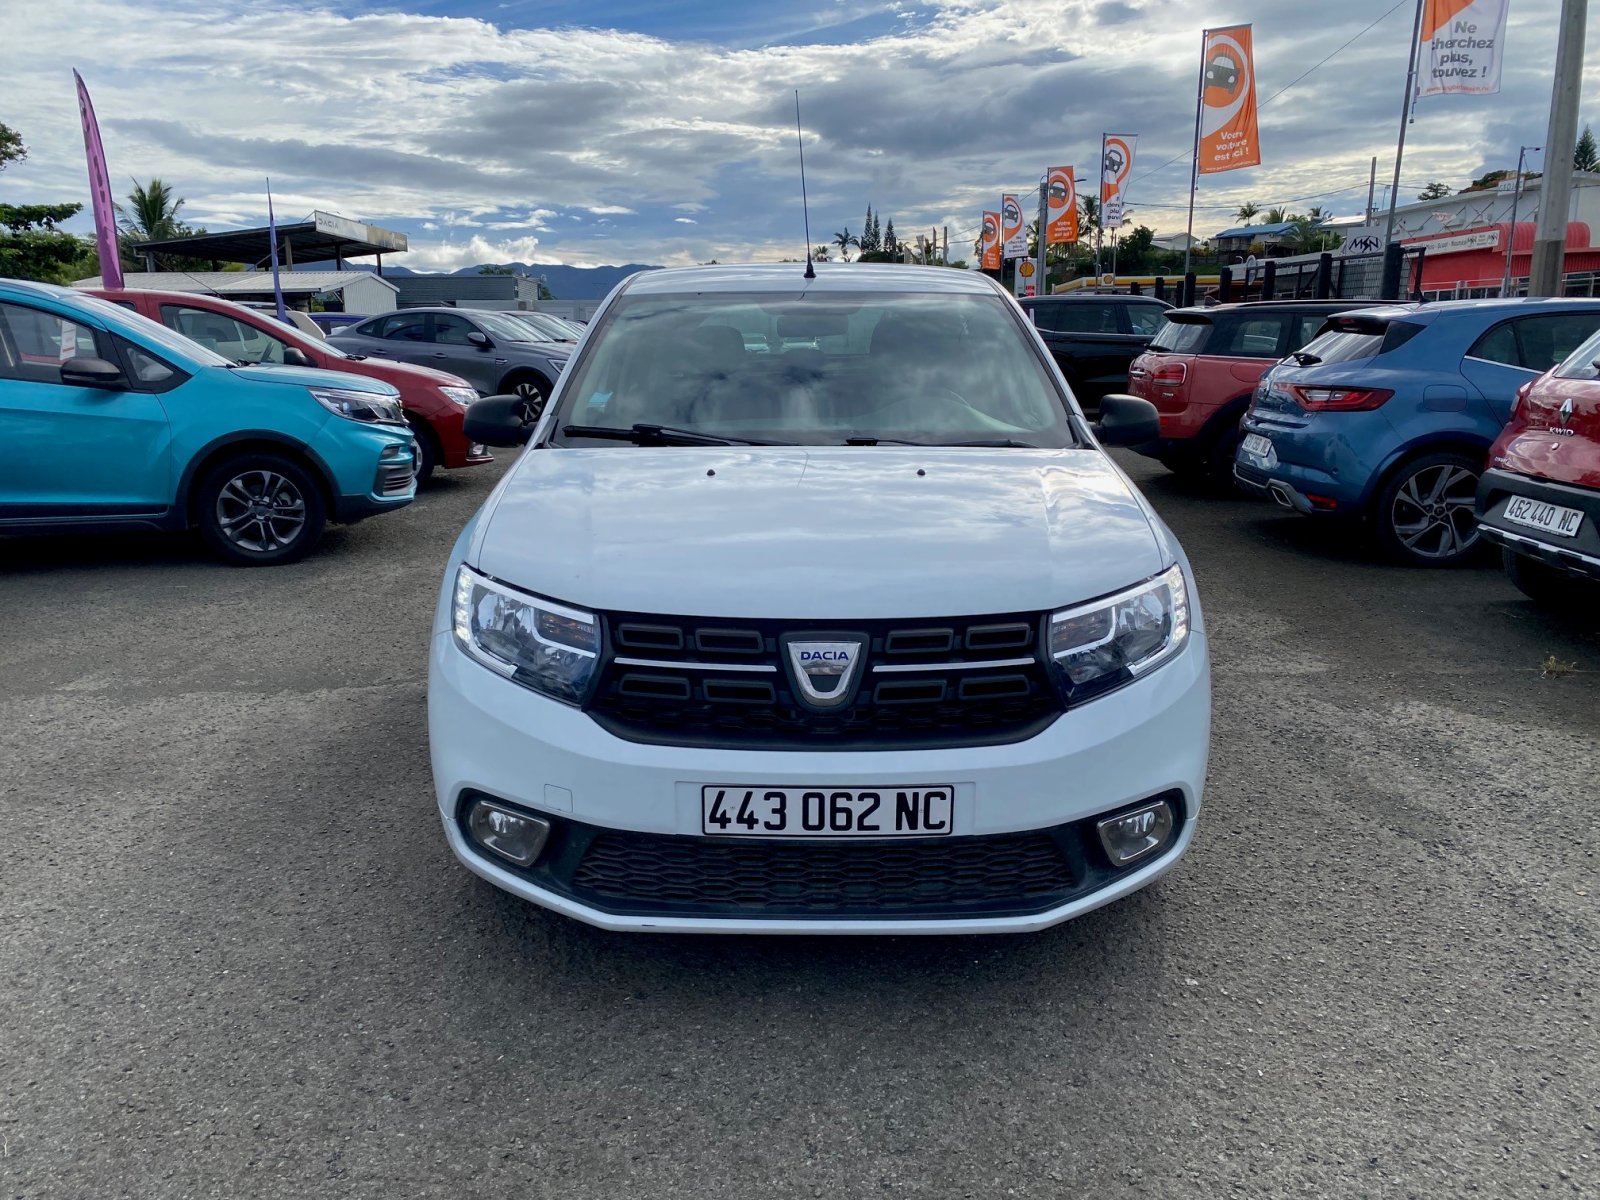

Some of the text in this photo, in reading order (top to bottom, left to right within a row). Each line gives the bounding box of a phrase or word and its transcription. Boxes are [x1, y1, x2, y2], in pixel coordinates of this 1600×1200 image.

[1454, 21, 1477, 33] Ne
[1221, 131, 1244, 140] Votr
[1214, 152, 1230, 161] est
[318, 217, 339, 229] DACIA
[1349, 236, 1379, 253] MSN
[1550, 427, 1574, 436] KWID
[1508, 498, 1578, 532] 462 440 NC
[801, 651, 849, 660] DACIA
[708, 790, 947, 832] 443 062 NC
